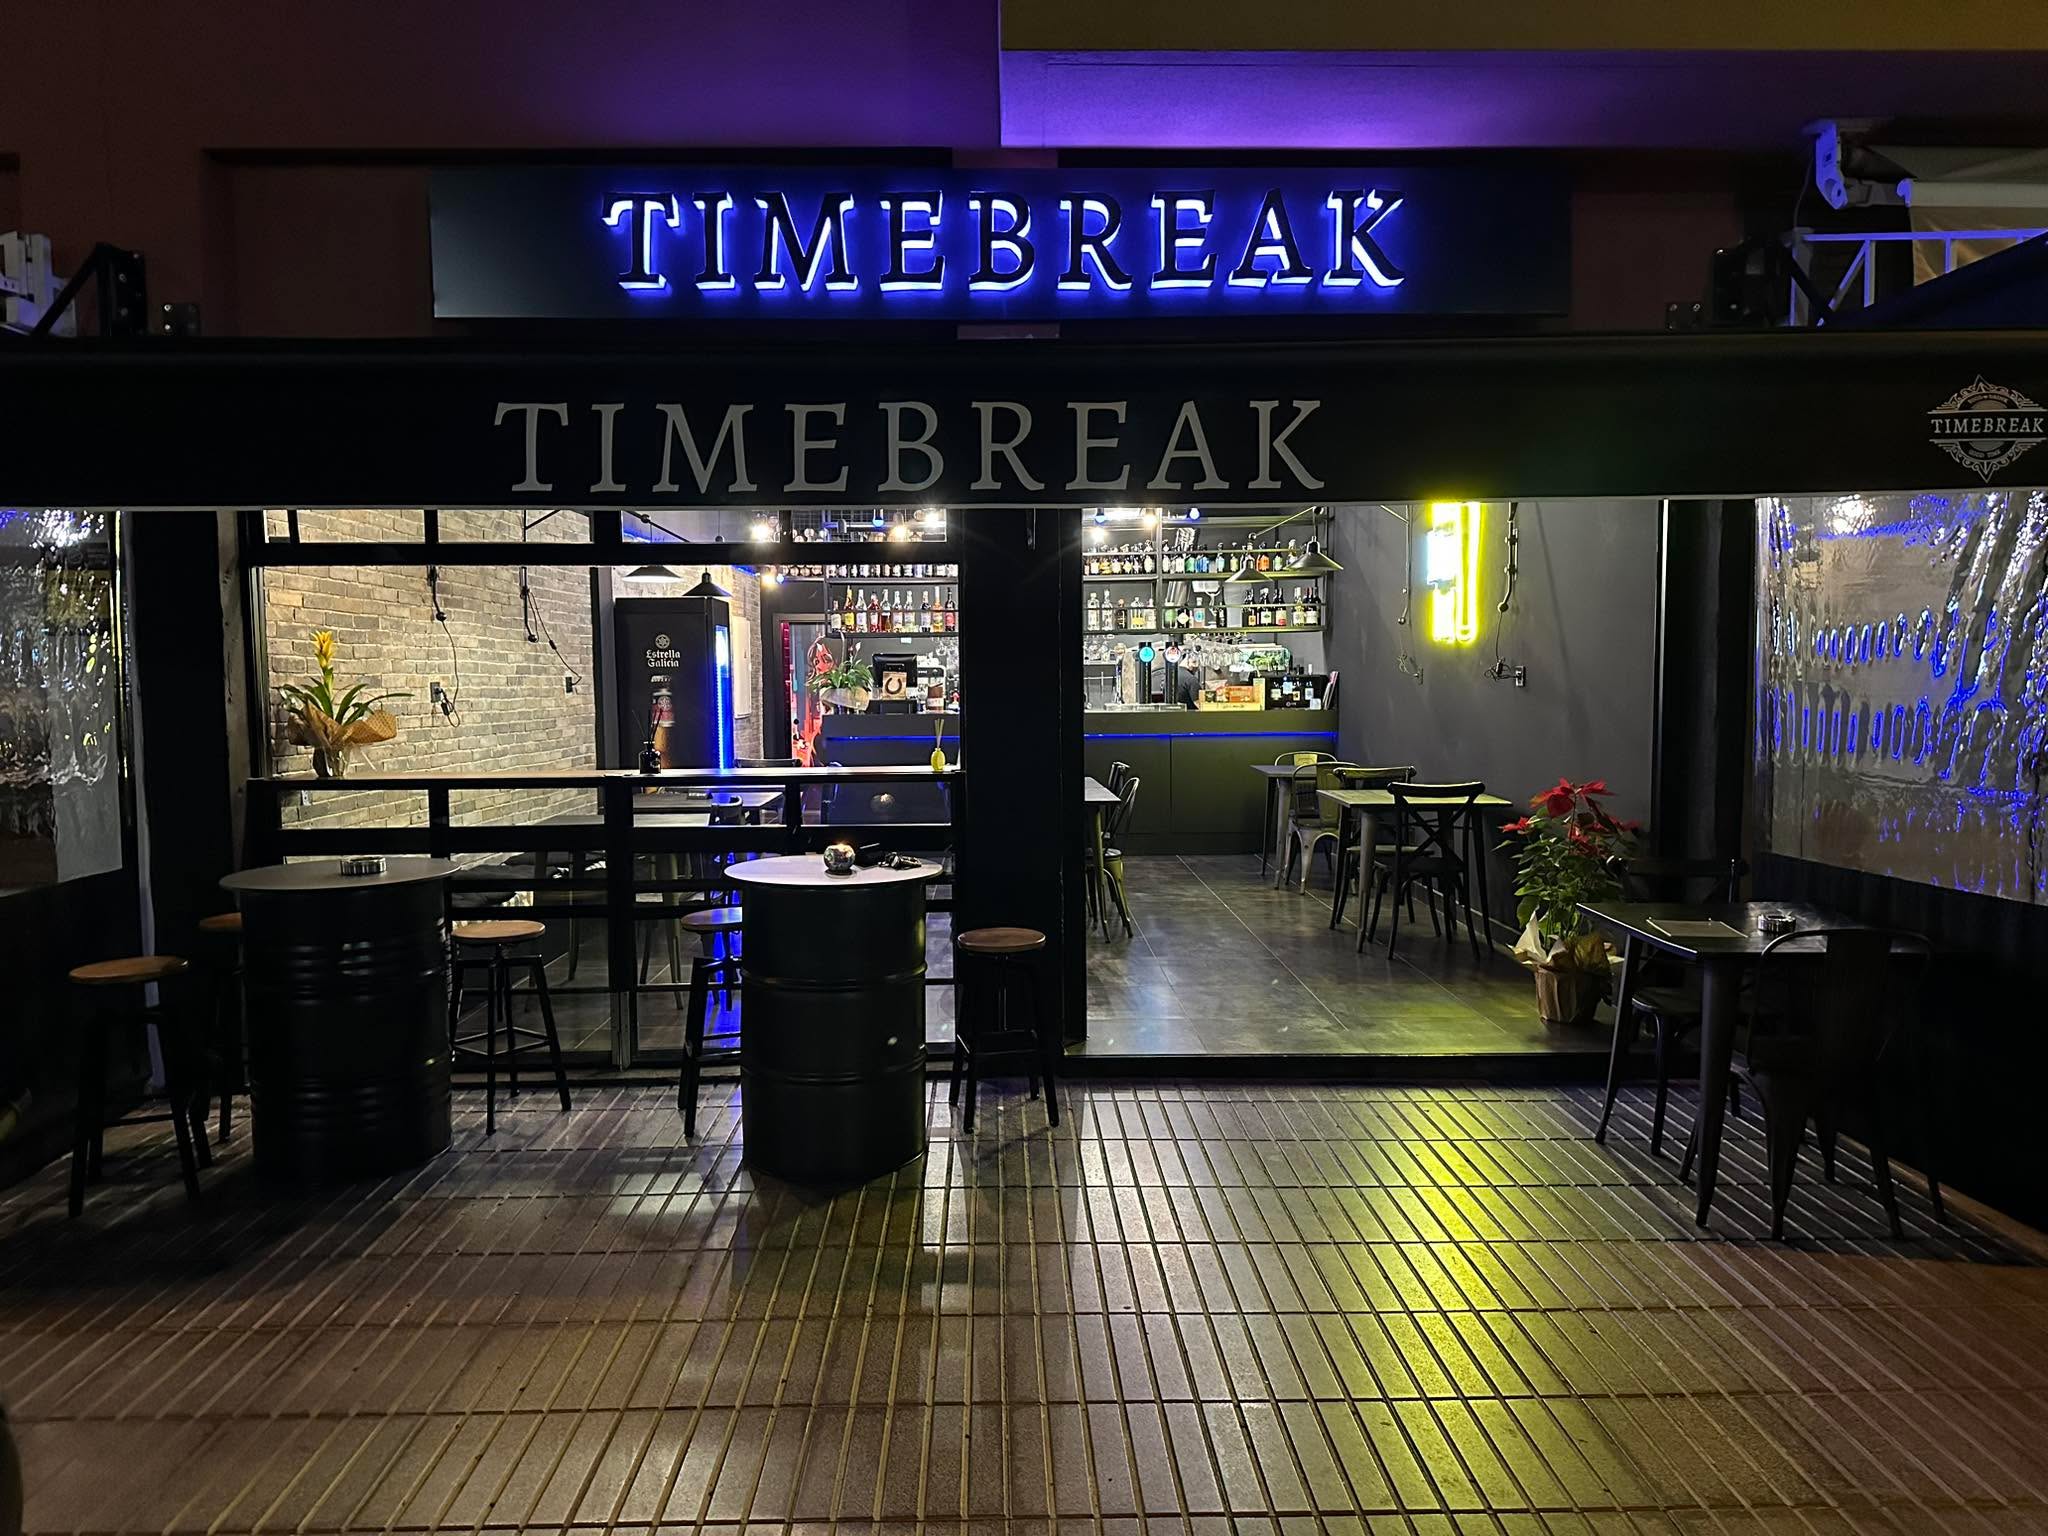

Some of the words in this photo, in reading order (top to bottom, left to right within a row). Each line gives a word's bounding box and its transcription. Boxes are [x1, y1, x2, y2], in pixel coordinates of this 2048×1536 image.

[602, 191, 1404, 292] TIMEBREAK
[1931, 417, 2044, 434] TIMEBREAK
[494, 399, 1325, 494] TIMEBREAK
[646, 649, 681, 659] Estrella
[647, 658, 680, 668] Galicia
